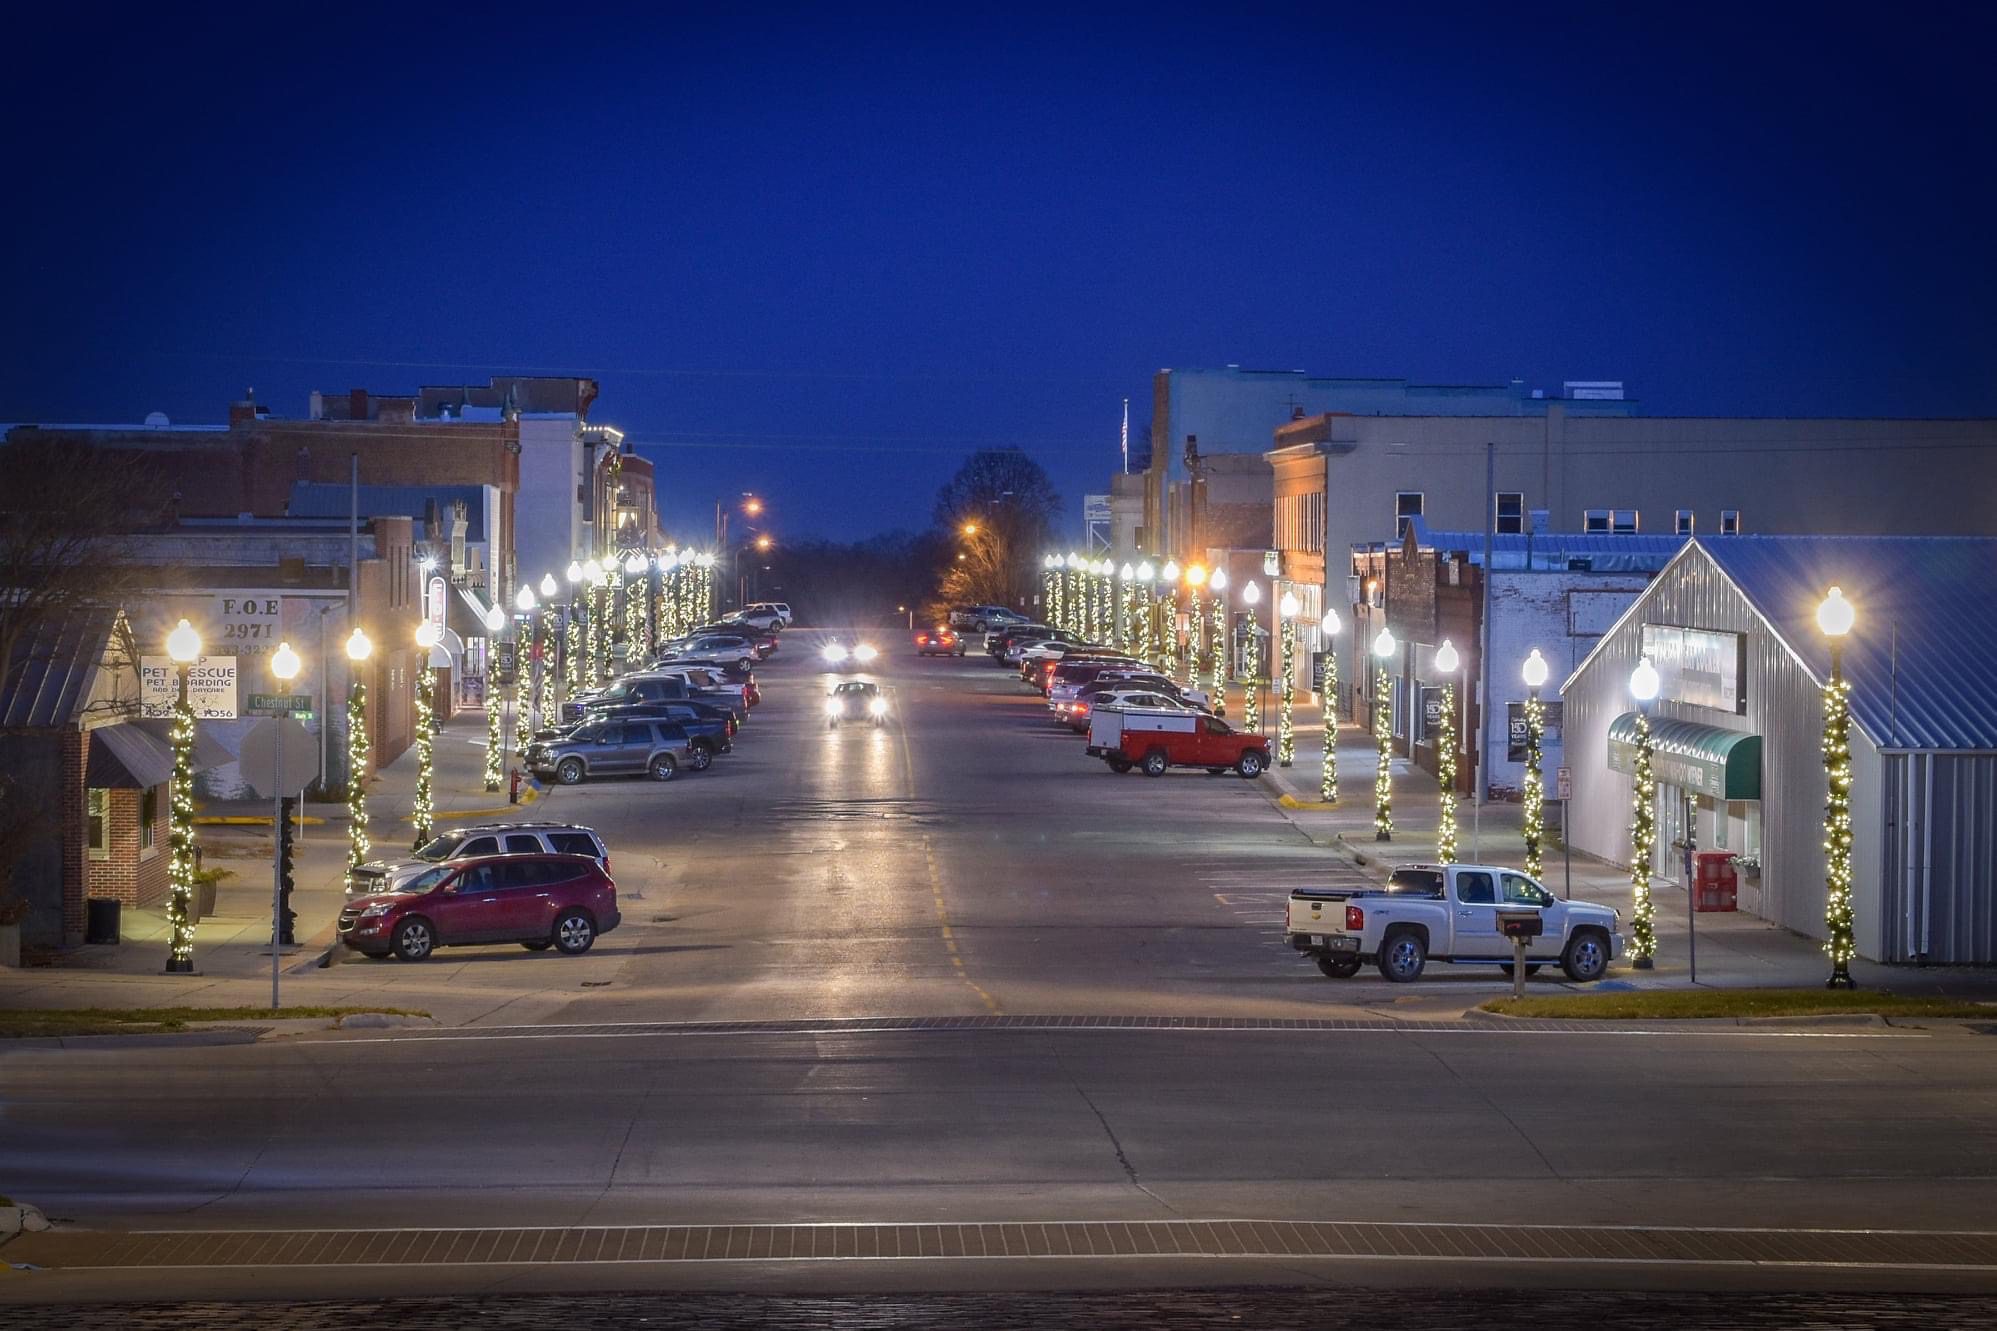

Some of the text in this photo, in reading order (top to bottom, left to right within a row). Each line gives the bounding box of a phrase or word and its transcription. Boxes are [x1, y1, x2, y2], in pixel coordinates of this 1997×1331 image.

[223, 599, 279, 615] F.O.E
[224, 624, 272, 639] 2971
[143, 668, 235, 678] PET ESCUE
[255, 696, 305, 709] Chestnut St
[1511, 722, 1528, 734] 150
